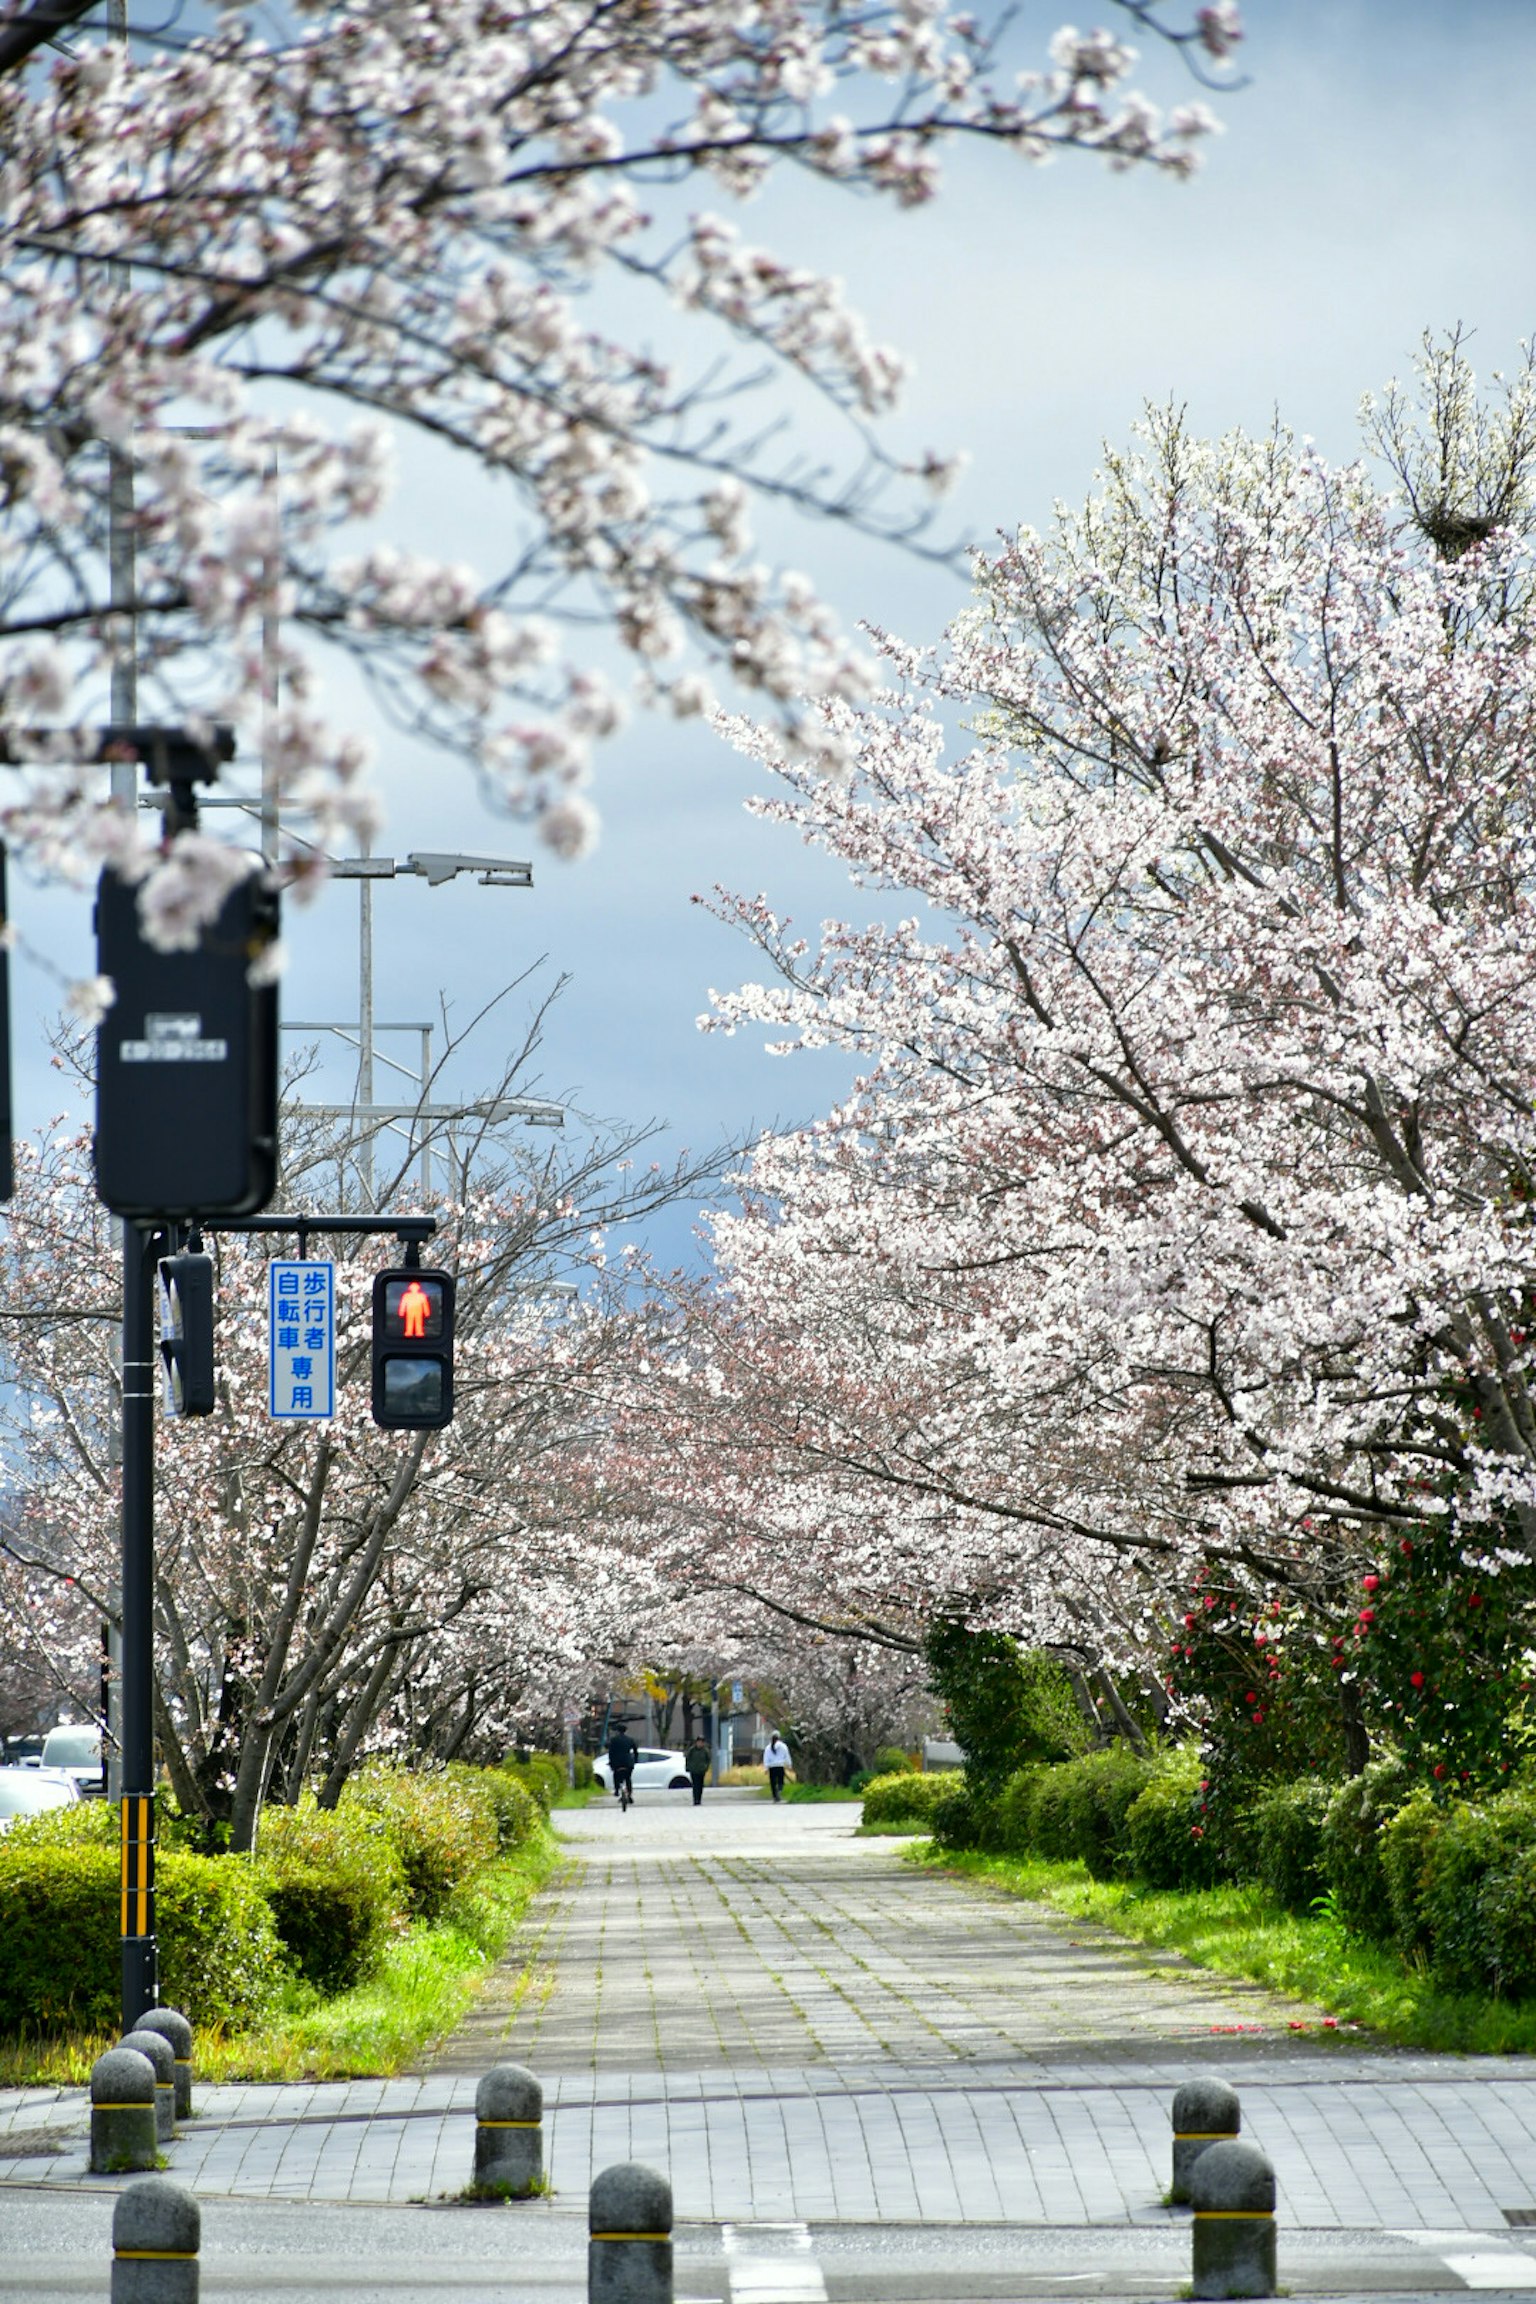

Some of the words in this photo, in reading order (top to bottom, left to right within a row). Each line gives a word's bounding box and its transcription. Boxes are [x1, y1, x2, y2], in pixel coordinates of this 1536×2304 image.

[277, 1271, 300, 1350] 自転車
[303, 1271, 326, 1350] 歩行者
[290, 1356, 313, 1409] 専用
